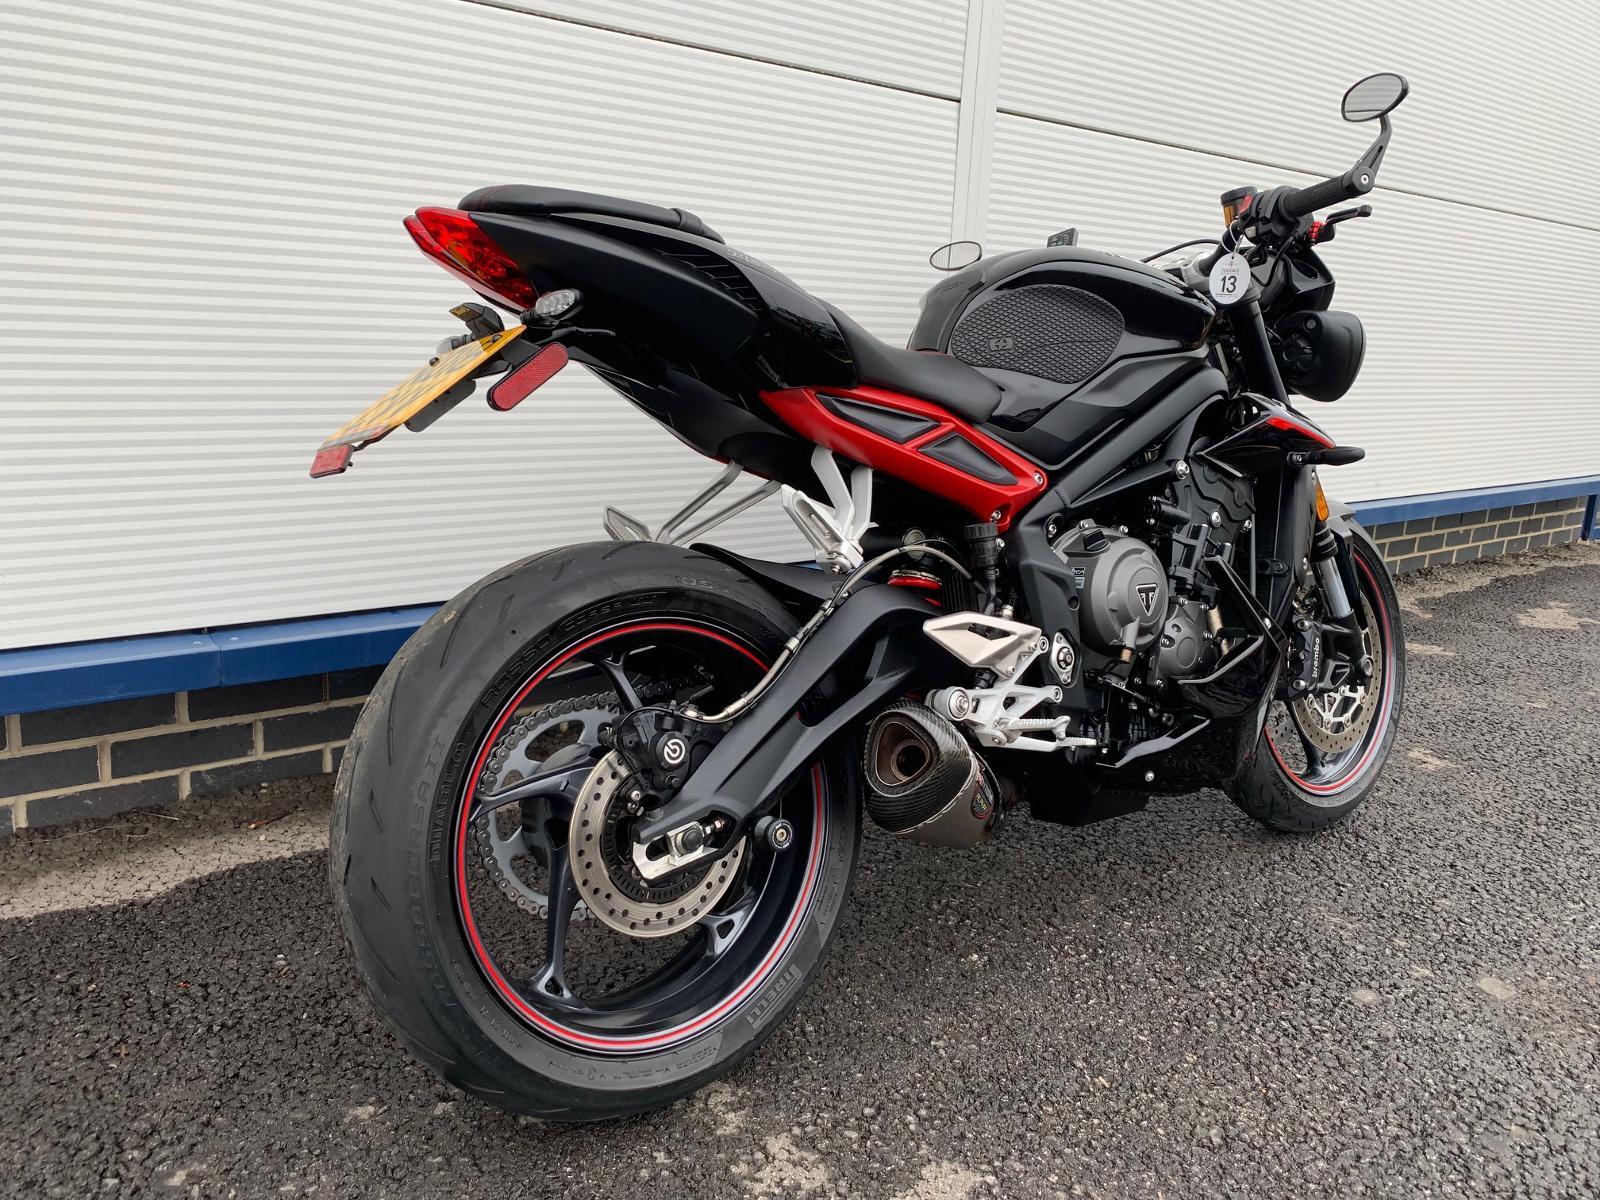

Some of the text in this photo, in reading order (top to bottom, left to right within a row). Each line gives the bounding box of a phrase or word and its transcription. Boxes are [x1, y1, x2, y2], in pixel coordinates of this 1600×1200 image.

[1221, 275, 1237, 293] 13
[1312, 637, 1320, 678] brembo
[745, 963, 804, 1029] PIRELLI
